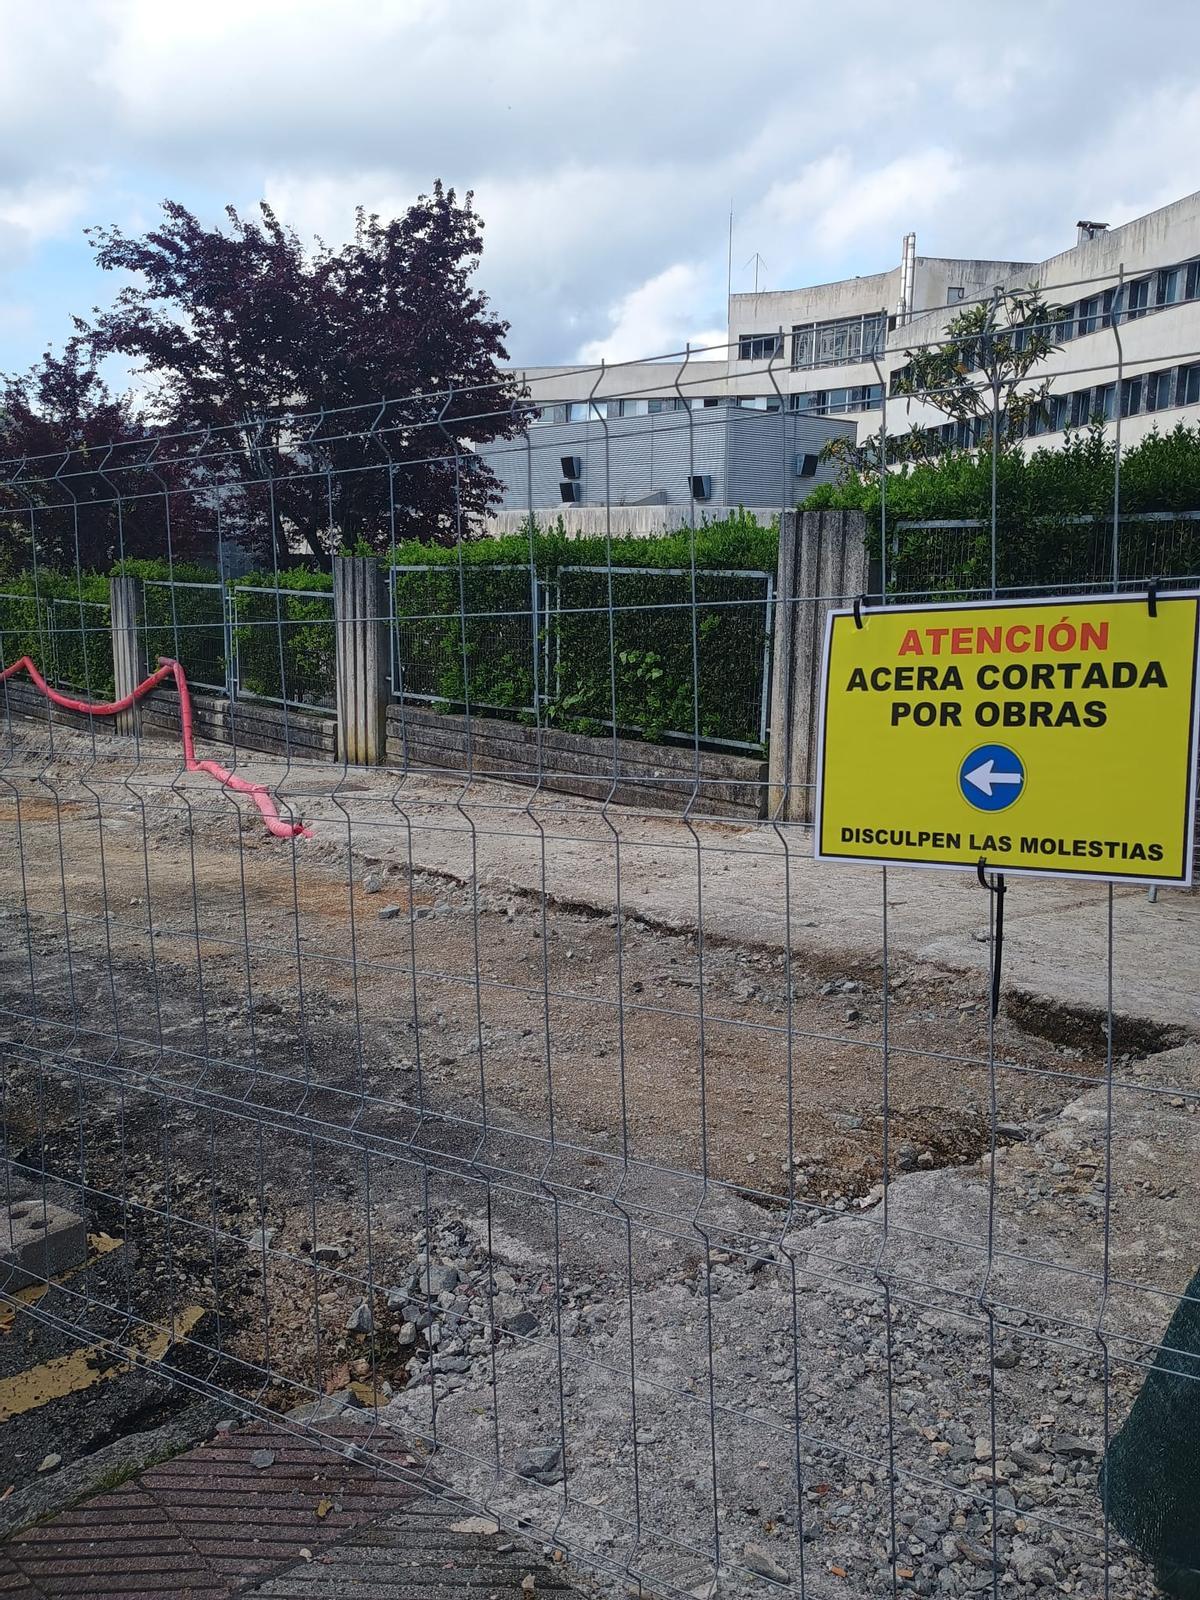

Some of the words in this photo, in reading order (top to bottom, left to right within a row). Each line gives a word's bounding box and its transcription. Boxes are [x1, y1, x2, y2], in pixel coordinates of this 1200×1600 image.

[899, 616, 1109, 656] ATENCIÓN
[846, 665, 964, 692] ACERA
[976, 661, 1168, 690] CORTADA
[890, 702, 962, 727] POR
[974, 701, 1108, 727] OBRAS
[841, 827, 961, 850] DISCULPEN
[969, 834, 1012, 852] LAS
[1020, 837, 1164, 862] MOLESTIAS
